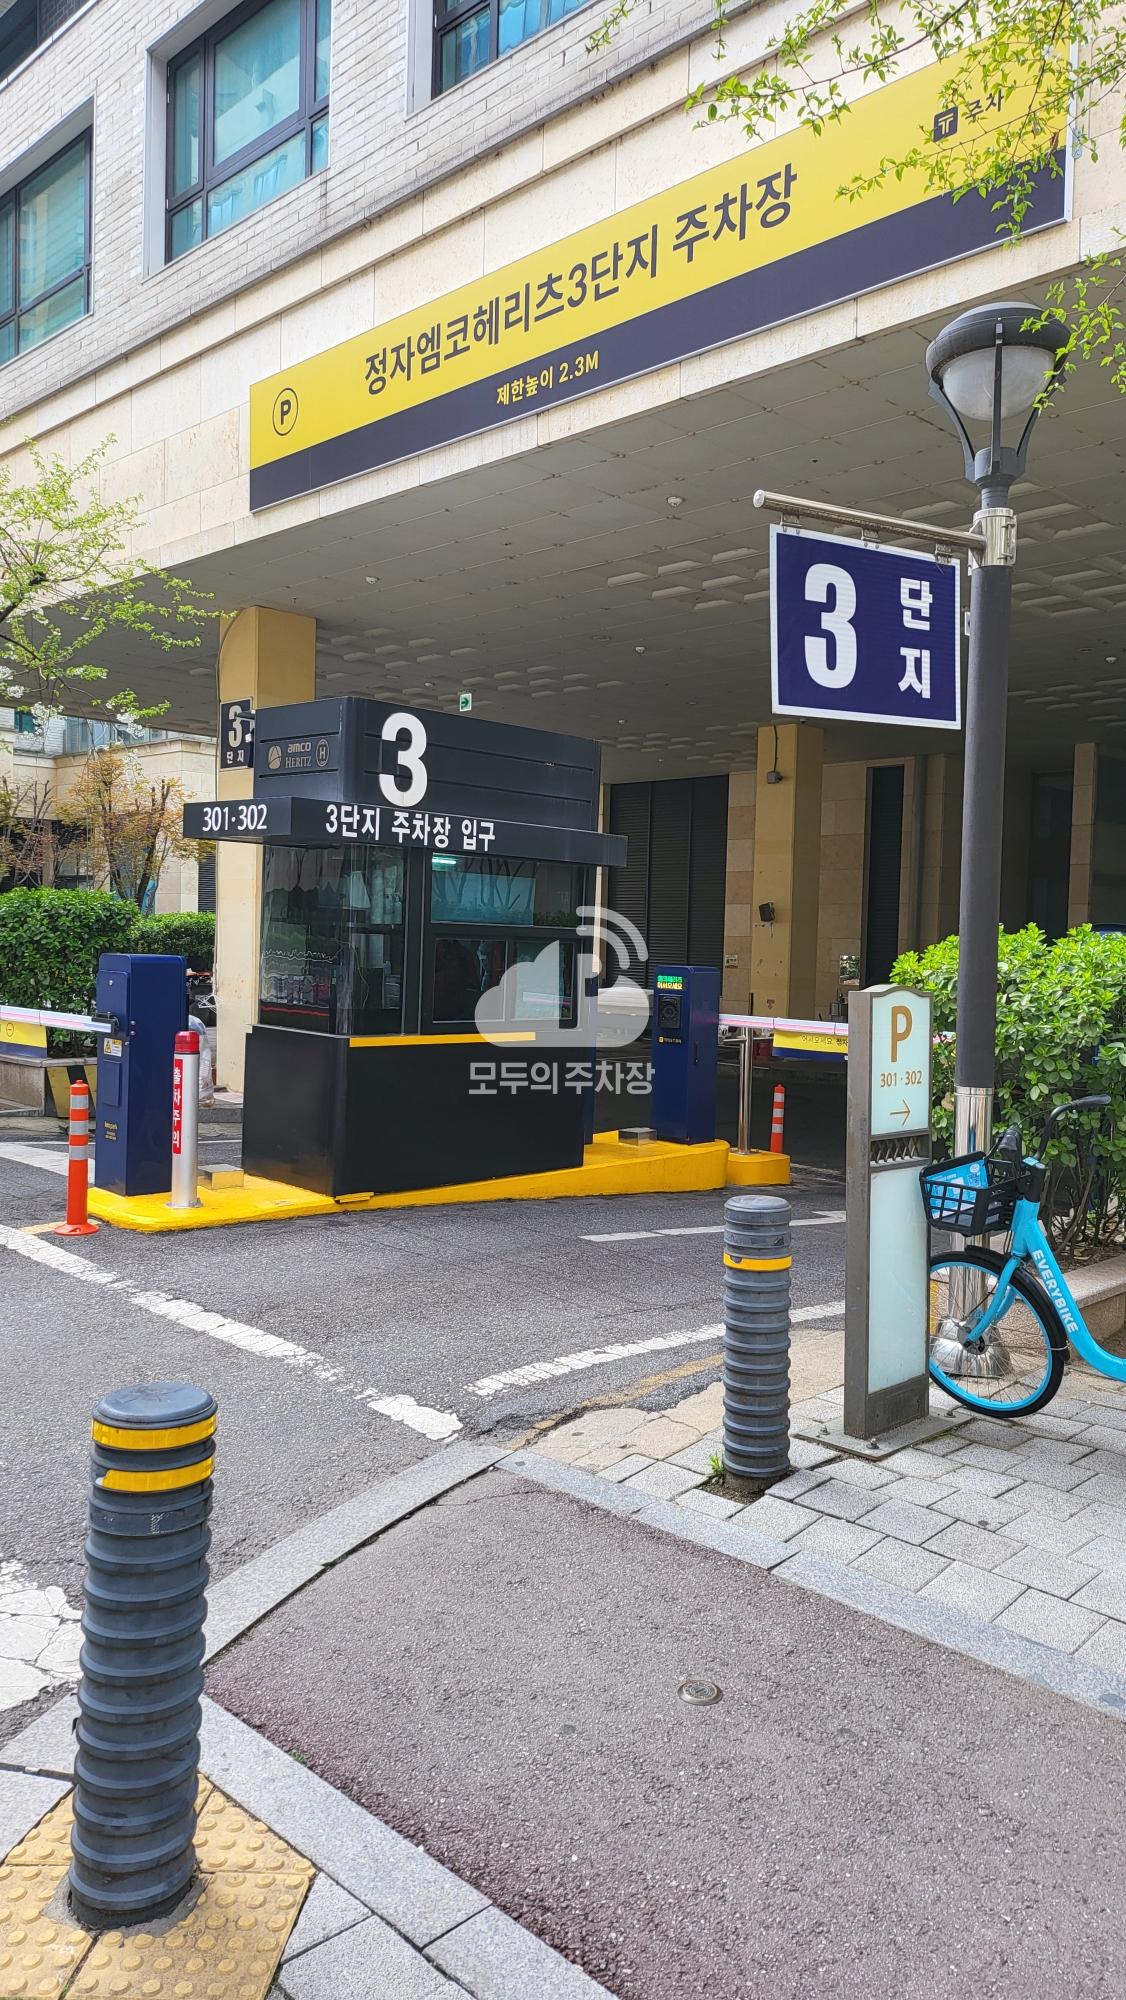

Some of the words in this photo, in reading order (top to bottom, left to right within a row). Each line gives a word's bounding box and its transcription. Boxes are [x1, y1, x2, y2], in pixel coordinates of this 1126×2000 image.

[964, 88, 1005, 124] 주차
[364, 223, 659, 396] 정자엠코헤리츠3단지
[672, 163, 798, 263] 주차장
[496, 368, 553, 406] 제한높이
[558, 350, 599, 383] 2.3M
[804, 563, 858, 689] 3
[898, 577, 933, 699] 단지
[228, 705, 243, 748] 3
[287, 742, 312, 753] amco
[226, 749, 245, 764] 단지
[285, 756, 312, 769] HERITZ
[378, 711, 428, 808] 3
[325, 803, 381, 841] 3단지
[391, 811, 451, 849] 주차장
[460, 818, 496, 852] 입구
[890, 1005, 913, 1063] P
[1032, 1249, 1079, 1333] EVERYBIKE
